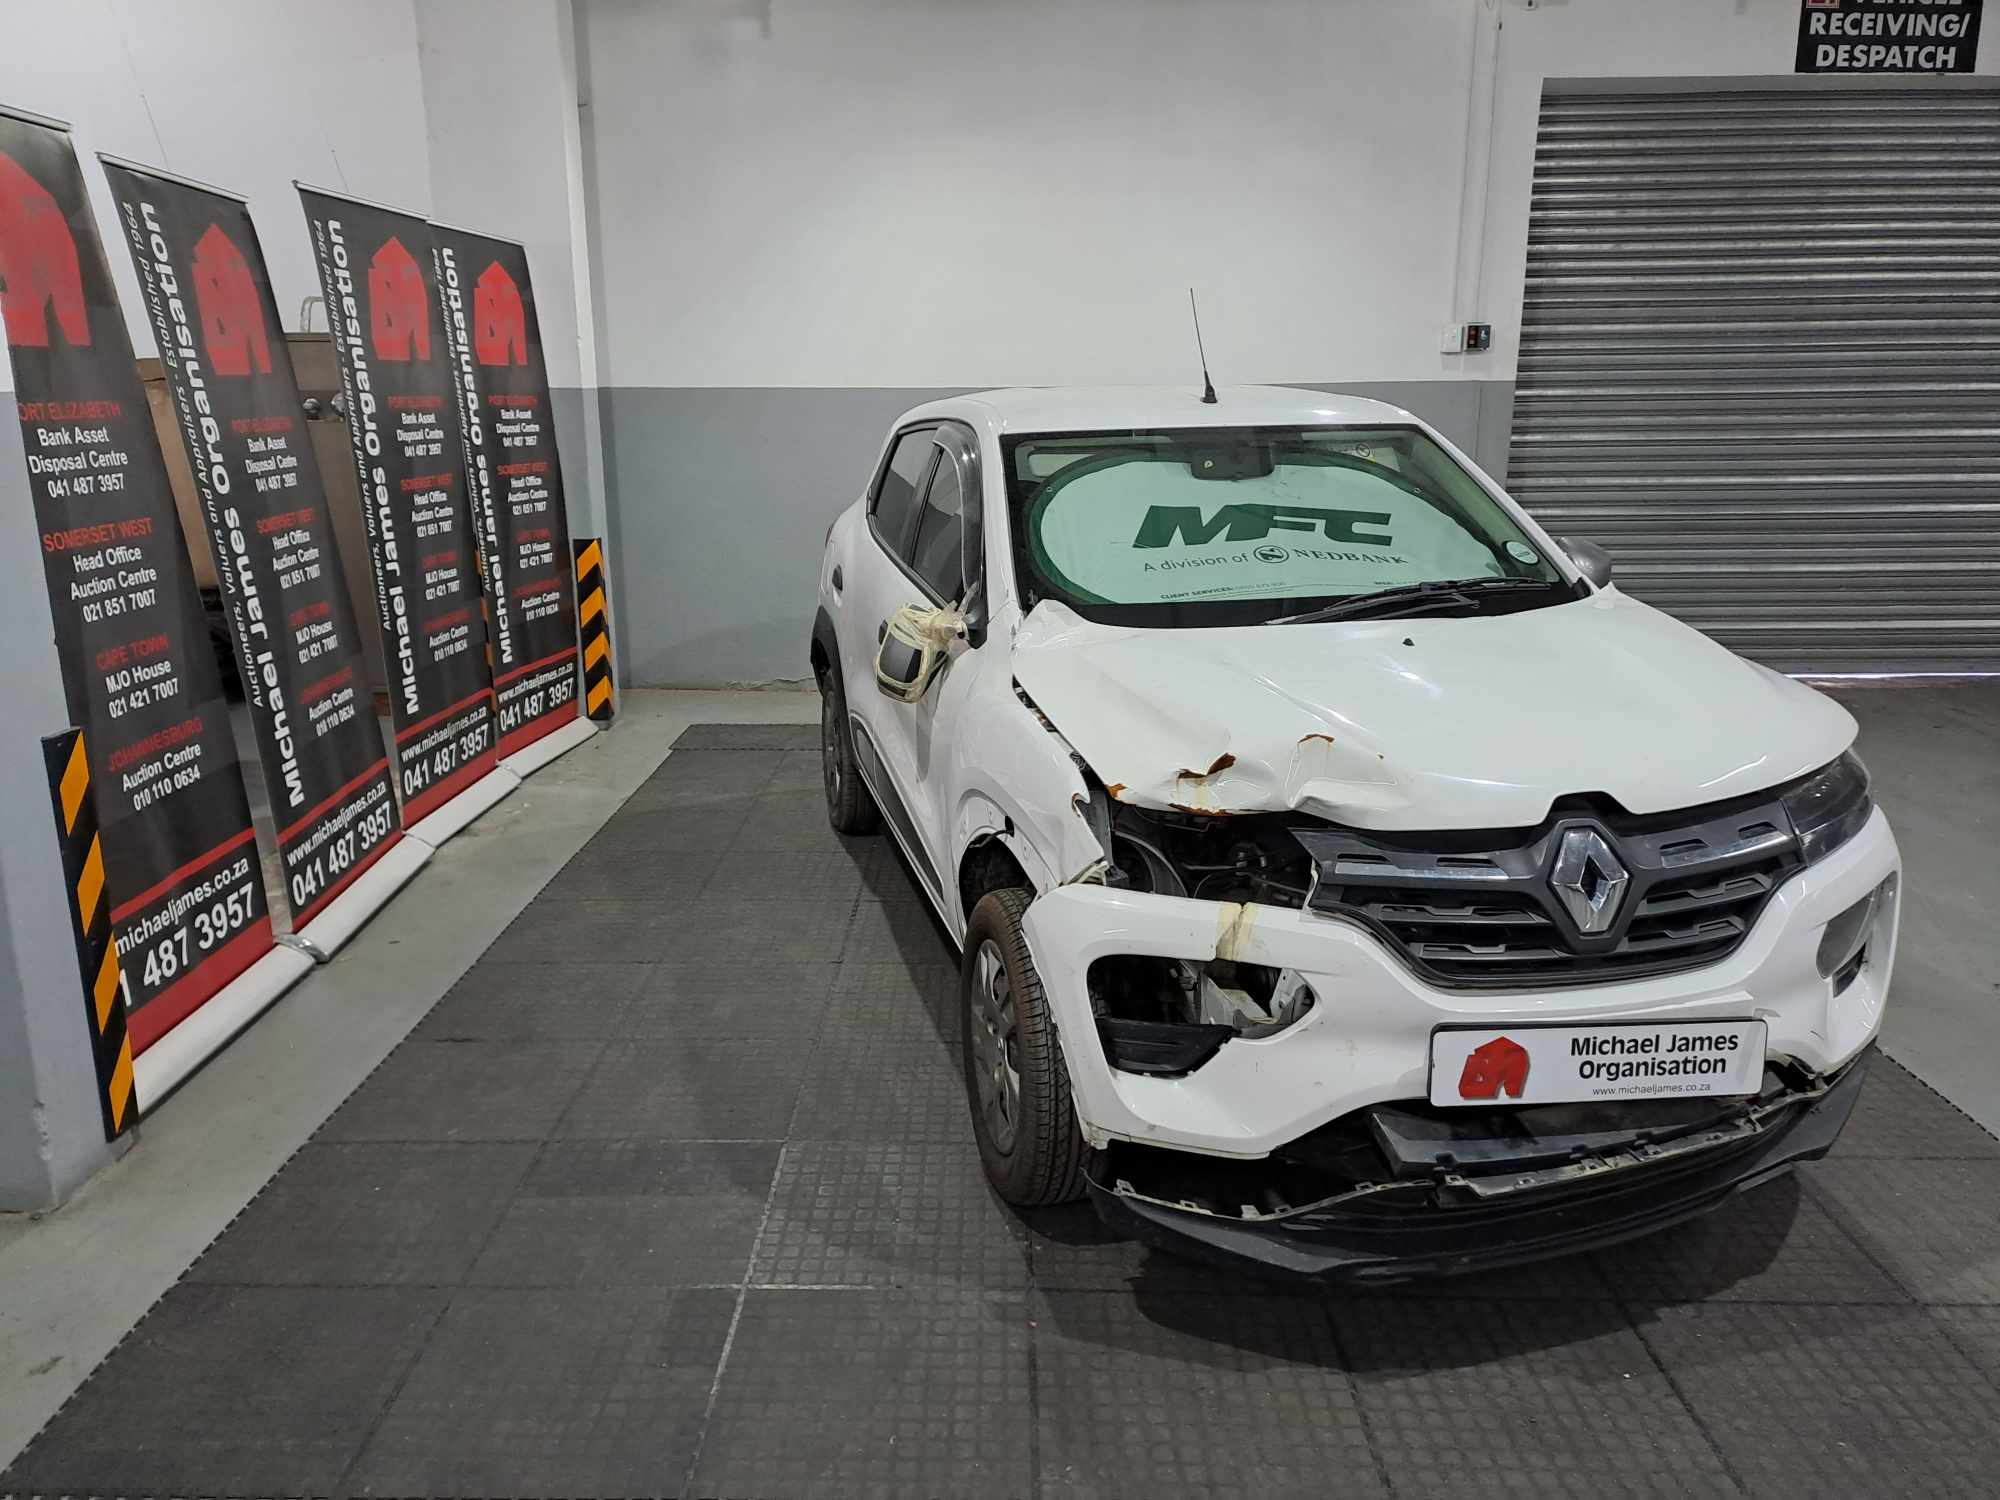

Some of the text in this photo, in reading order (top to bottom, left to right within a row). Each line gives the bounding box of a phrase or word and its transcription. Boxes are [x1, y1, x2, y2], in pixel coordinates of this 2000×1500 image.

[1809, 12, 1971, 38] RECEIVING/
[1816, 44, 1957, 69] DESPATCH
[123, 201, 144, 250] 1964
[313, 219, 328, 259] 1964
[138, 256, 178, 368] Established
[320, 261, 345, 353] Established
[18, 403, 46, 421] ORT
[342, 366, 362, 447] Appraisers
[37, 426, 109, 446] Bank Asset
[176, 386, 210, 484] Appraisers
[247, 437, 266, 452] Bank
[28, 450, 128, 475] Disposal Centre
[245, 456, 276, 474] Disposal
[328, 219, 420, 715] Michael James Organisation
[352, 450, 368, 479] and
[442, 247, 513, 664] Michael James Organisation
[48, 473, 124, 498] 041 487 3957
[268, 475, 281, 490] 487
[140, 202, 305, 808] Michael James Organisation
[201, 488, 218, 523] and
[362, 482, 377, 537] Valuers
[43, 517, 152, 551] SOMERSET WEST
[272, 533, 289, 550] Head
[1132, 503, 1392, 548] MFC
[73, 546, 142, 573] Head Office
[214, 529, 236, 594] Valuers
[273, 553, 297, 572] Auction
[1144, 548, 1409, 573] A division of NEDBANK
[71, 567, 157, 600] Auction Centre
[82, 589, 156, 622] 021 851 7007
[310, 621, 333, 639] House
[233, 601, 264, 708] Auctioneers,
[105, 659, 172, 694] MJO House
[108, 678, 179, 719] 021 421 7007
[309, 698, 333, 722] Auction
[500, 677, 574, 732] 041 487 3957
[401, 705, 487, 762] www.michaeljames.co.za
[122, 743, 201, 792] Auction Centre
[404, 723, 489, 796] 041 487 3957
[133, 765, 201, 811] 010 110 0634
[287, 781, 386, 867] www.michaeljames.co.za
[292, 800, 392, 906] 041 487 3957
[115, 857, 249, 957] michaeljames.co.za
[143, 881, 253, 987] 487 3957
[1570, 1032, 1739, 1057] Michael James
[1578, 1055, 1727, 1082] Organisation
[1592, 1081, 1711, 1097] www.michaeljames.co.za
